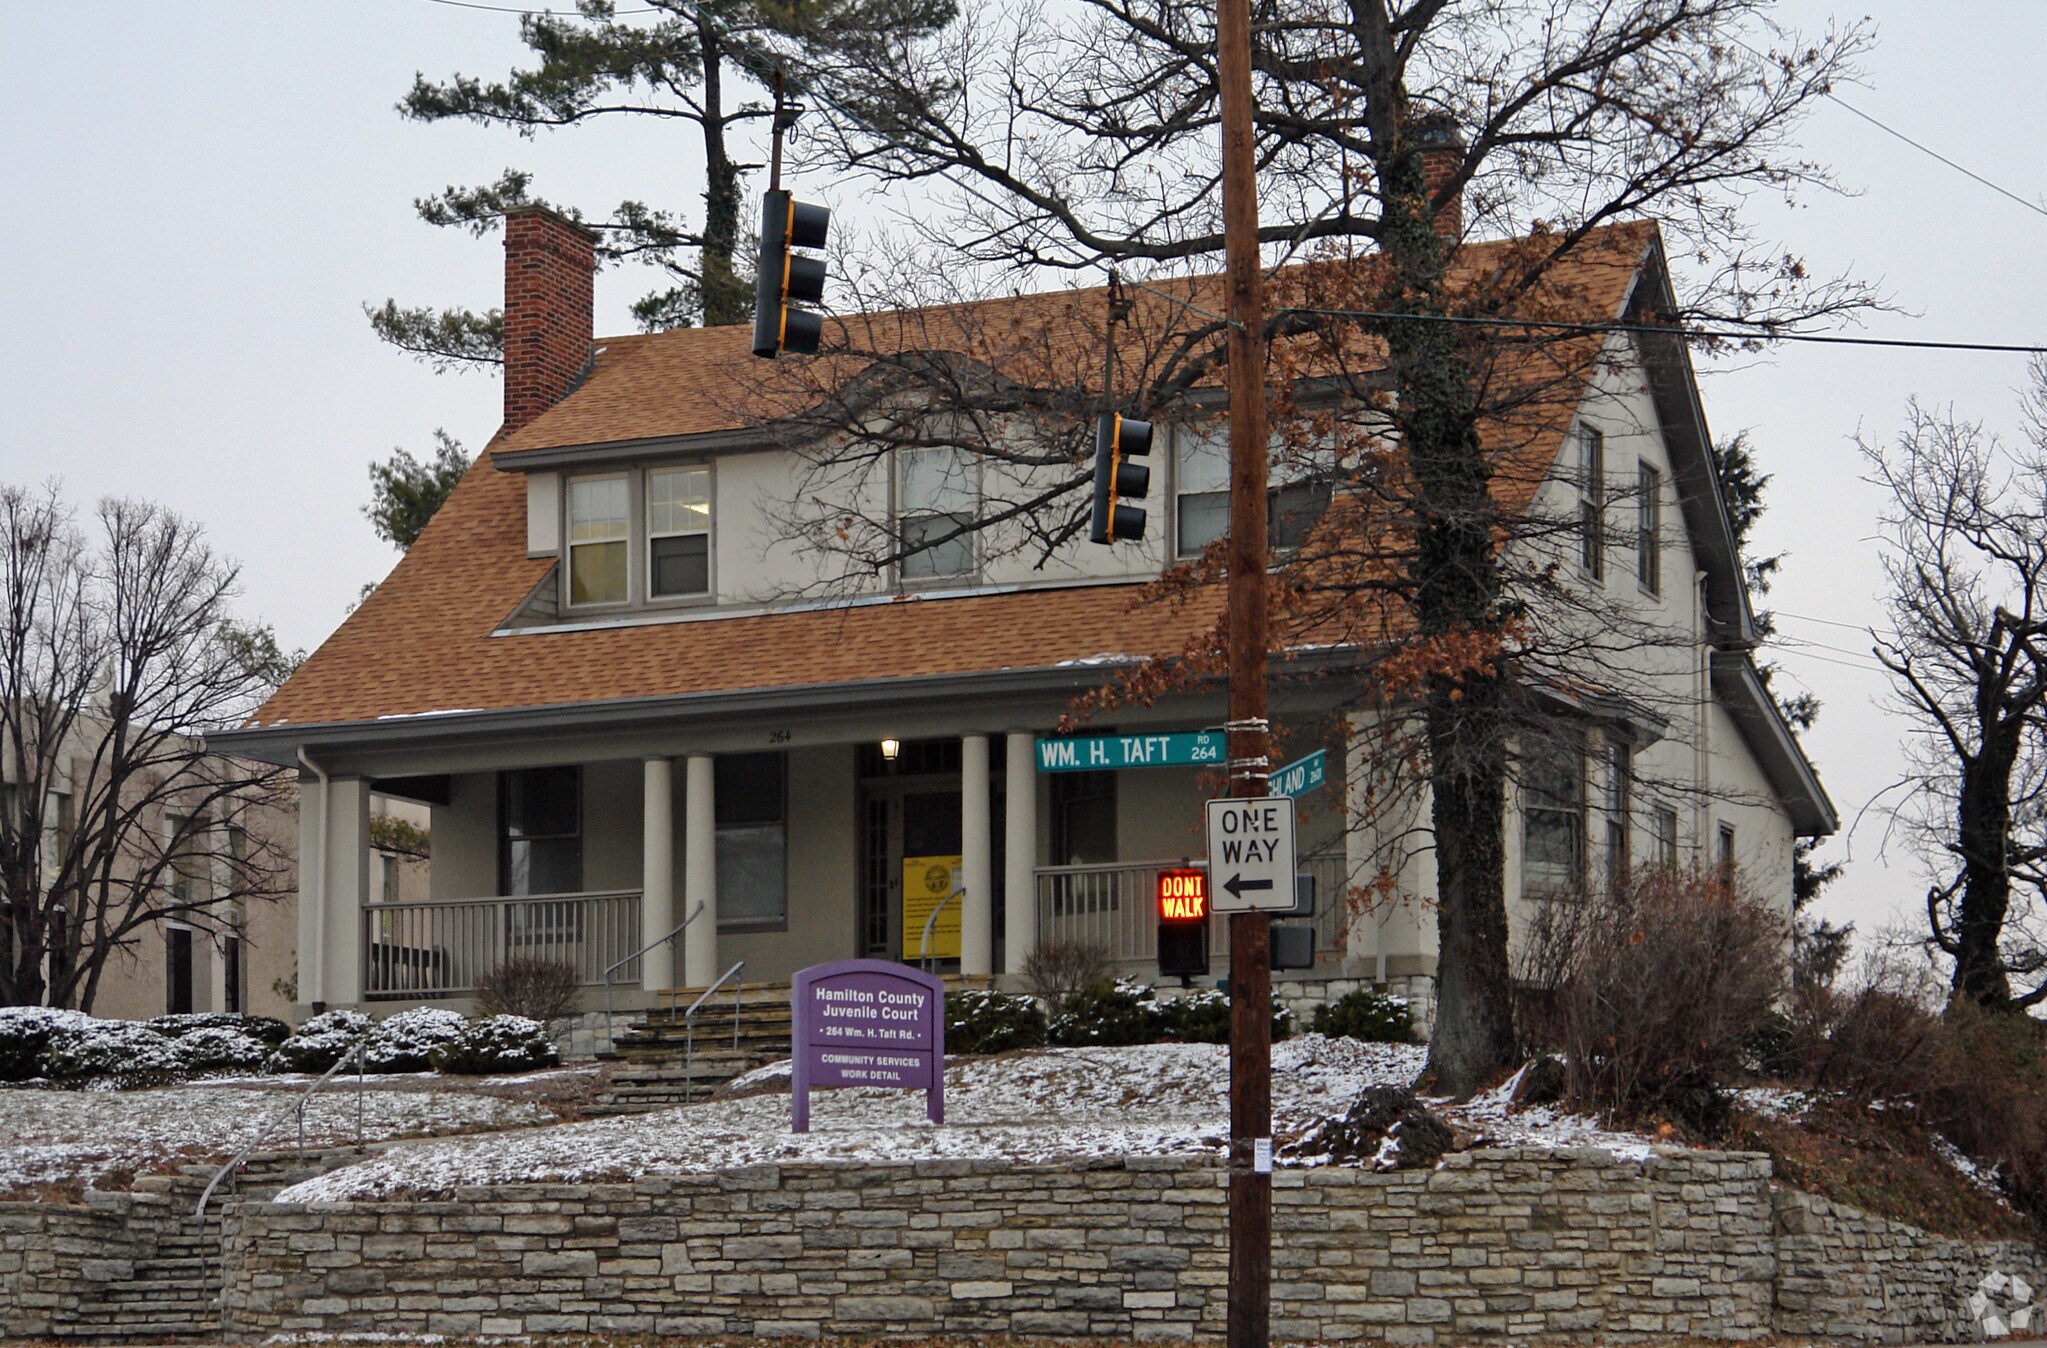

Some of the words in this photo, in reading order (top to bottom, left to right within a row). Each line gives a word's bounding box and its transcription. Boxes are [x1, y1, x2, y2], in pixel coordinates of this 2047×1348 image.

[769, 730, 791, 743] 264
[1197, 735, 1210, 745] RD
[1041, 743, 1081, 768] WM.
[1090, 740, 1110, 765] H.
[1120, 737, 1171, 763] TAFT
[1191, 746, 1217, 761] 264
[1221, 808, 1279, 834] ONE
[1222, 838, 1280, 864] WAY
[1162, 876, 1203, 897] DONT
[1162, 897, 1204, 918] WALK
[816, 987, 874, 1003] Hamilton
[878, 990, 925, 1008] County
[823, 1004, 878, 1019] Juvenile
[882, 1007, 918, 1020] Court
[826, 1026, 843, 1037] 264
[844, 1027, 865, 1038] Wm.
[867, 1029, 878, 1038] H.
[879, 1029, 897, 1039] Taft
[899, 1030, 915, 1040] Rd.
[821, 1053, 875, 1066] COMMUNITY
[877, 1056, 920, 1067] SERVICES
[841, 1069, 868, 1079] WORK
[870, 1070, 901, 1080] DETAIL
